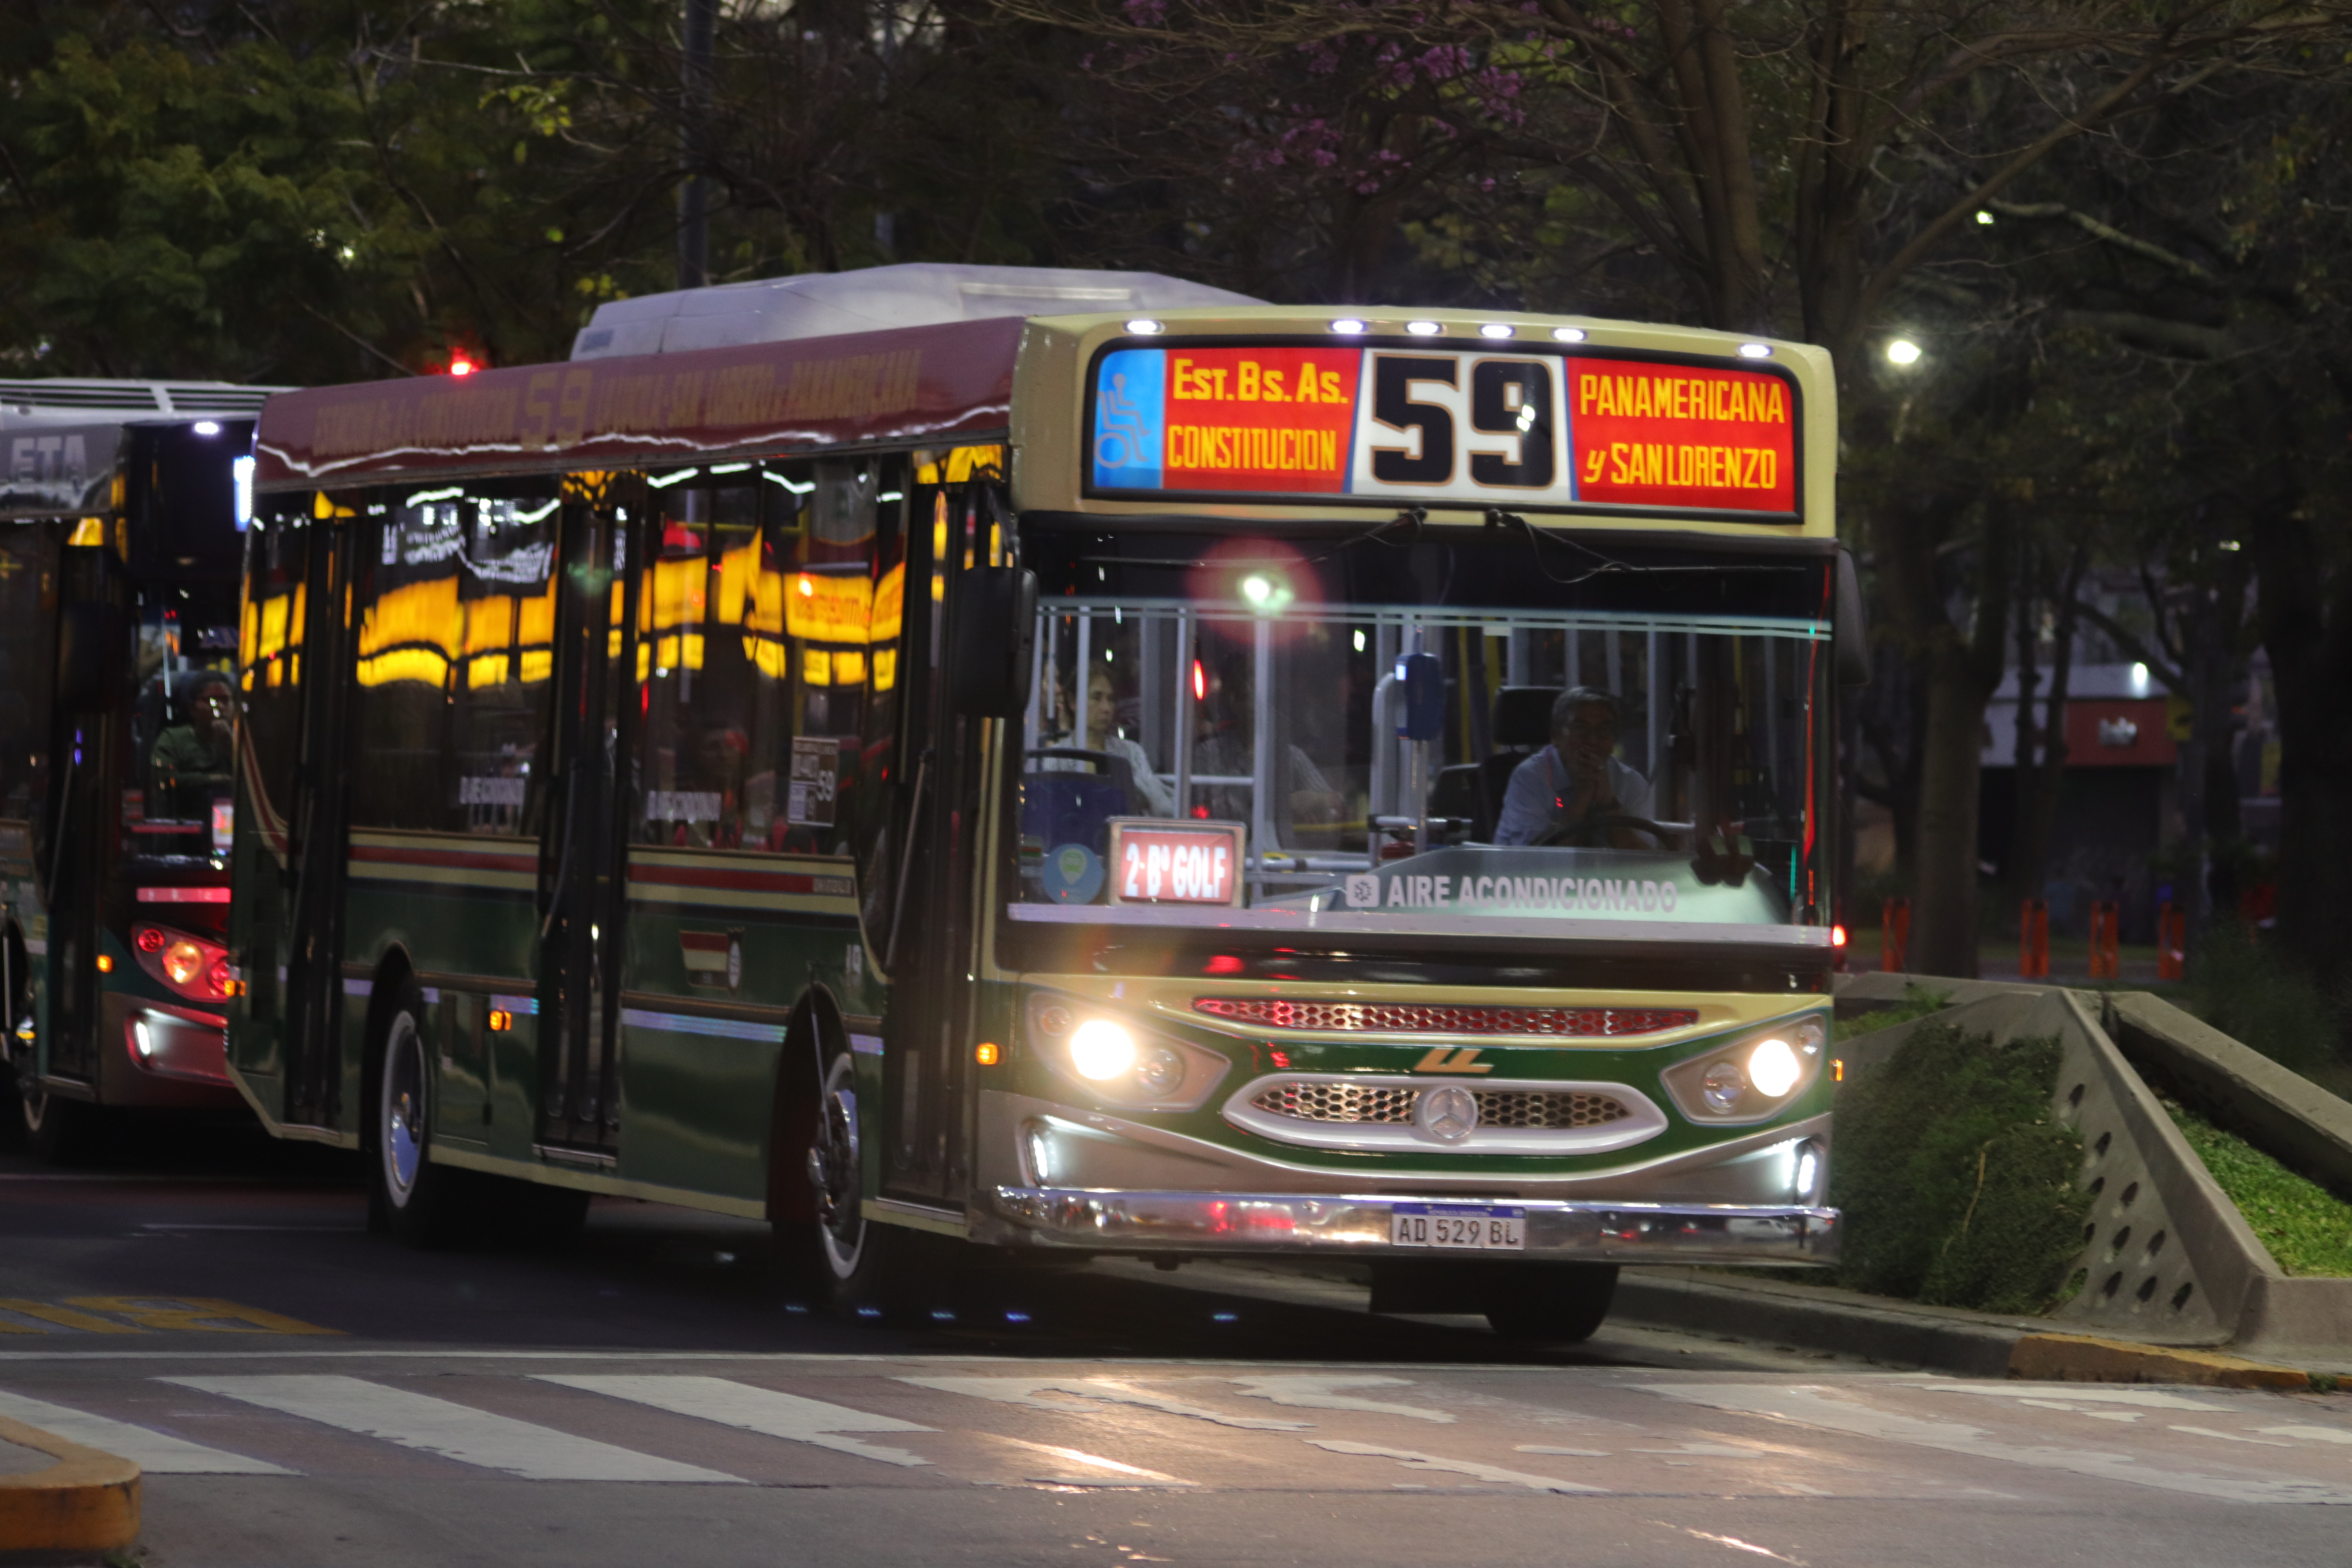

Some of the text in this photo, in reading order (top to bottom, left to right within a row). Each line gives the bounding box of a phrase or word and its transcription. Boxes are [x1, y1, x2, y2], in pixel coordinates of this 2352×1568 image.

[520, 369, 593, 451] 59
[1370, 352, 1557, 490] 59
[1580, 374, 1786, 423] PANAMERICANA
[1167, 425, 1337, 471] CONSTITUCION
[1610, 442, 1663, 486] SAN
[1666, 445, 1777, 489] LORENZO
[1172, 844, 1227, 898] GOLF
[1387, 875, 1678, 913] AIRE ACONDICIONADO
[1399, 1218, 1519, 1245] AD 529 BL
